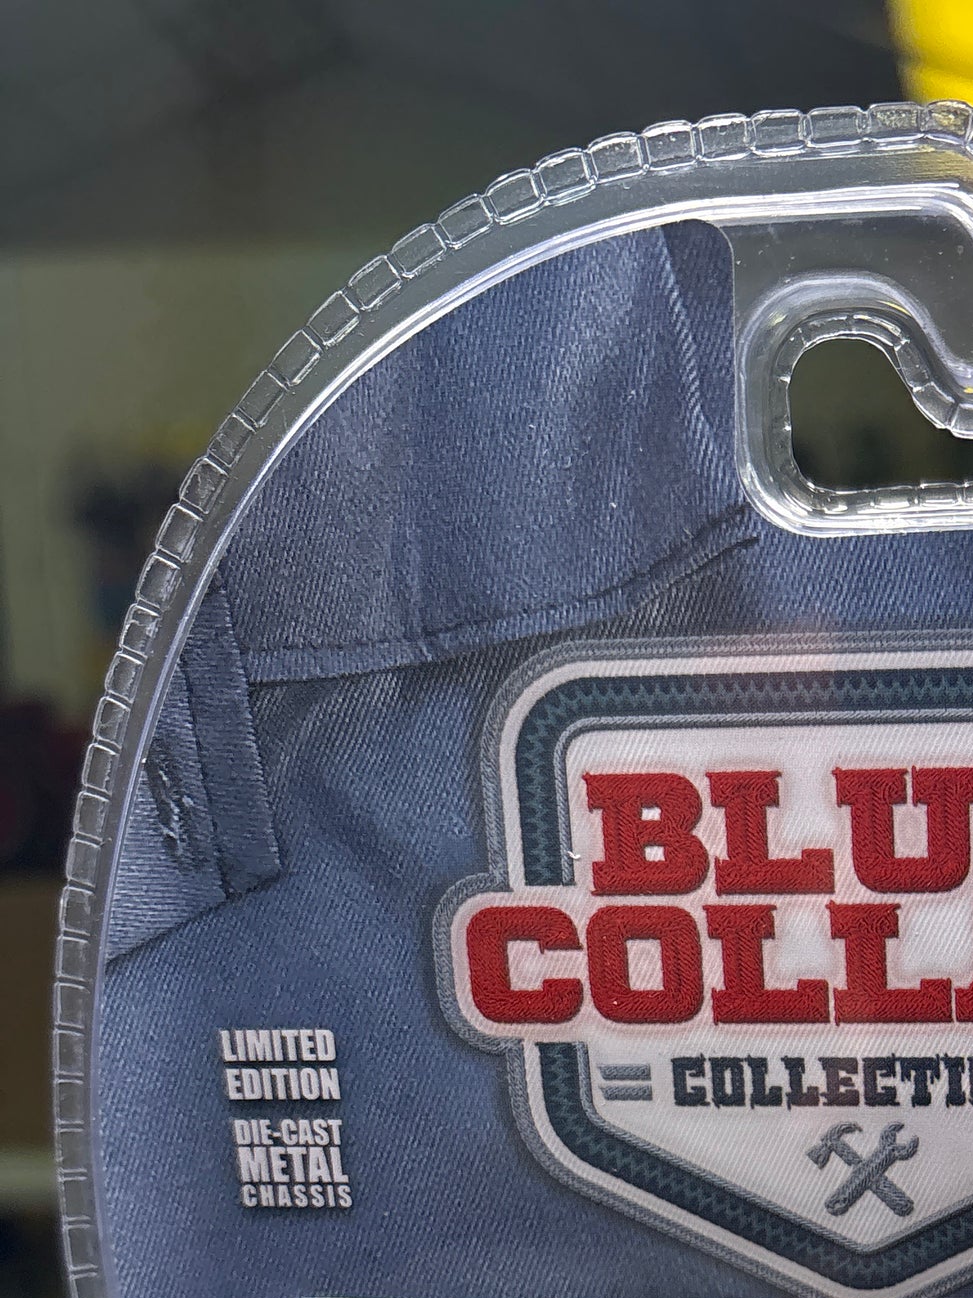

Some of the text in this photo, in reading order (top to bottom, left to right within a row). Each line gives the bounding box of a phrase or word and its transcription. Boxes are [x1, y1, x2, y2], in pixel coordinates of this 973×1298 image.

[219, 1029, 337, 1062] LIMITED
[225, 1067, 342, 1100] EDITION
[232, 1118, 343, 1146] DIE-CAST
[237, 1146, 350, 1183] METAL
[241, 1184, 353, 1208] CHASSIS
